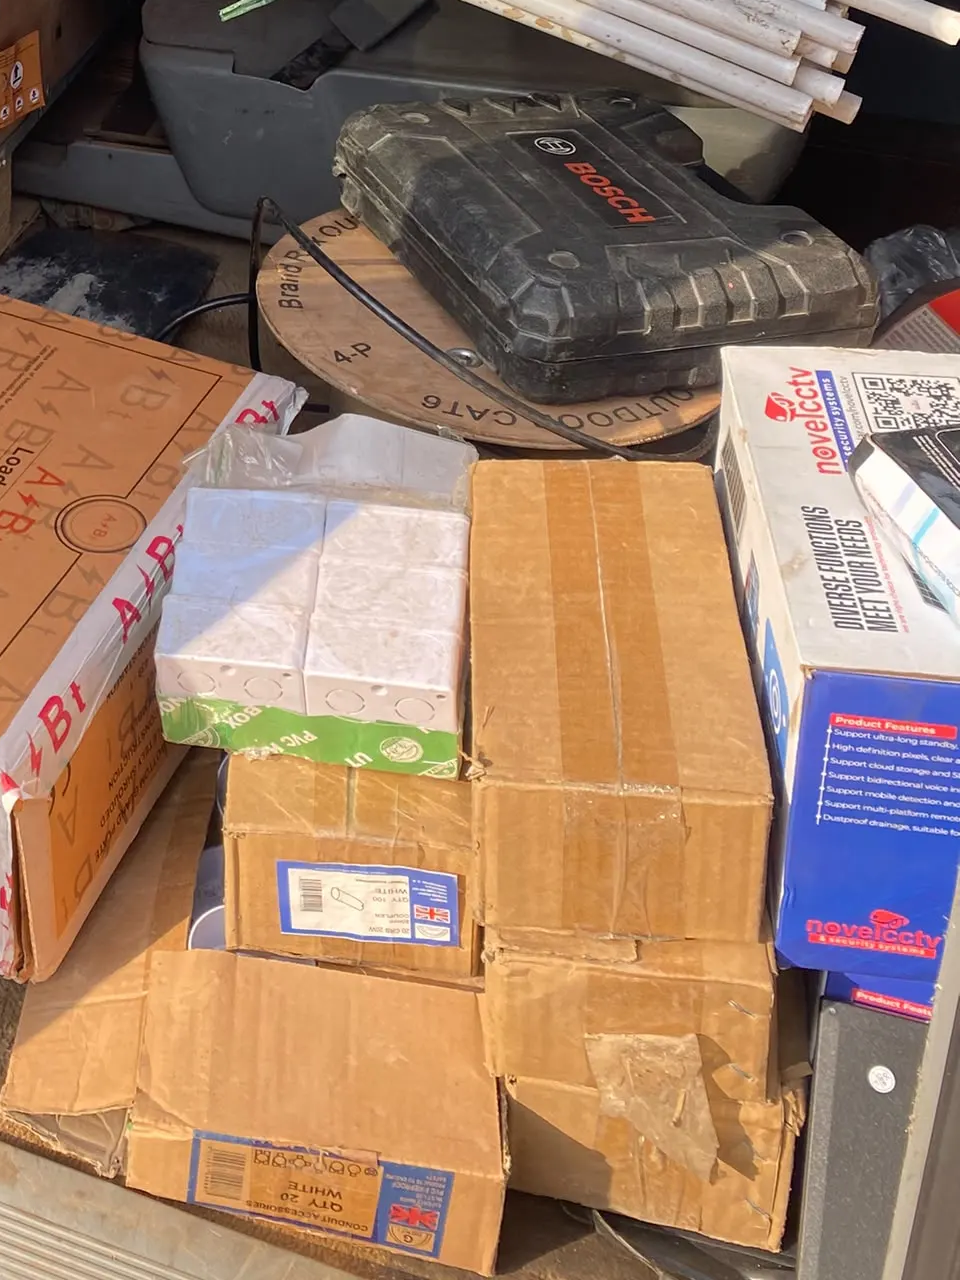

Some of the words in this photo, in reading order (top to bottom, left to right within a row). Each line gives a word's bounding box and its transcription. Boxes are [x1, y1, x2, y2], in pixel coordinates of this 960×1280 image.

[564, 161, 655, 224] BOSCH
[319, 215, 360, 237] OU
[822, 376, 842, 418] systems
[422, 394, 517, 426] CAT6
[788, 366, 843, 476] novelcctv
[834, 417, 856, 457] security
[801, 506, 841, 572] FUNCTIONS
[835, 518, 881, 563] NEEDS
[846, 558, 889, 600] YOUR
[820, 570, 865, 632] DIVERSE
[857, 596, 899, 633] MEET
[835, 716, 882, 729] Product
[885, 722, 937, 735] Features
[280, 729, 318, 748] PVC
[834, 728, 872, 740] Support
[873, 733, 919, 746] ultra-long
[832, 743, 855, 753] High
[856, 746, 901, 757] definition
[931, 755, 954, 764] clear
[830, 757, 867, 769] Support
[868, 762, 895, 772] cloud
[896, 766, 931, 777] storage
[932, 770, 951, 778] and
[828, 771, 865, 783] Support
[867, 776, 924, 789] bidirectional
[925, 784, 949, 792] voice
[826, 785, 864, 797] Support
[865, 790, 897, 801] mobile
[898, 795, 942, 806] detection
[824, 800, 861, 811] Support
[862, 805, 930, 819] multi-platform
[823, 813, 869, 825] Dustproof
[912, 825, 949, 836] suitable
[806, 918, 942, 949] novelcctv
[829, 936, 876, 949] security
[878, 942, 926, 956] systems
[855, 991, 902, 1009] Product
[280, 1192, 299, 1203] 20
[288, 1181, 343, 1200] WHITE
[246, 1199, 320, 1223] ACCESSORIES
[309, 1198, 343, 1213] QTY
[321, 1214, 368, 1232] CONDUIT
